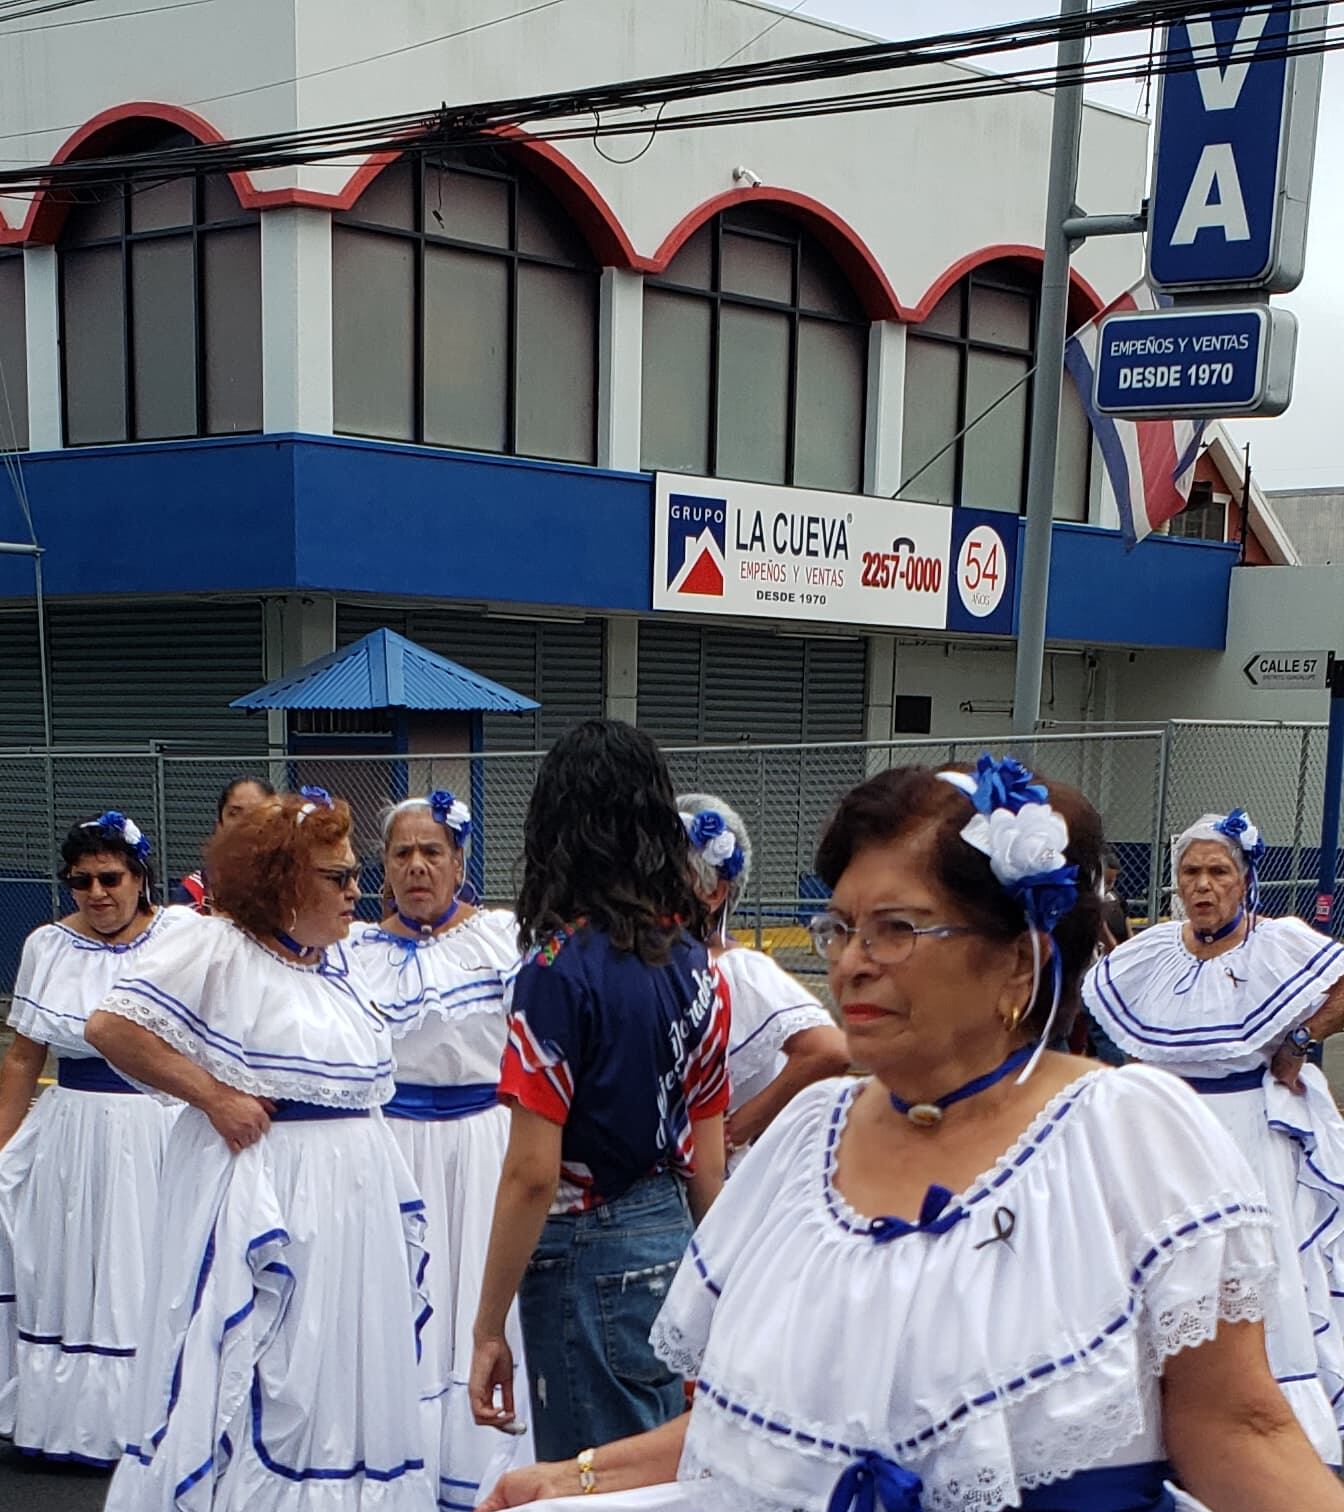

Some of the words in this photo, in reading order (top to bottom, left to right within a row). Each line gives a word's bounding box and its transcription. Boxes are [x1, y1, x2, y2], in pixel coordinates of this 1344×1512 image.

[1110, 335, 1174, 356] EMPEÑOS
[1177, 336, 1188, 352] Y
[1192, 333, 1249, 352] VENTAS
[1118, 365, 1181, 390] DESDE
[1187, 363, 1233, 386] 1970
[671, 505, 724, 524] GRUPO
[736, 508, 765, 552] LA
[773, 512, 849, 560] CUEVA
[740, 560, 786, 583] EMPEÑOS
[793, 564, 799, 583] Y
[806, 566, 844, 588] VENTAS
[861, 551, 943, 593] 2257-0000
[965, 541, 998, 590] 54
[756, 590, 795, 603] DESDE
[800, 592, 826, 605] 1970
[1260, 660, 1300, 673] CALLE
[1303, 660, 1318, 673] 57
